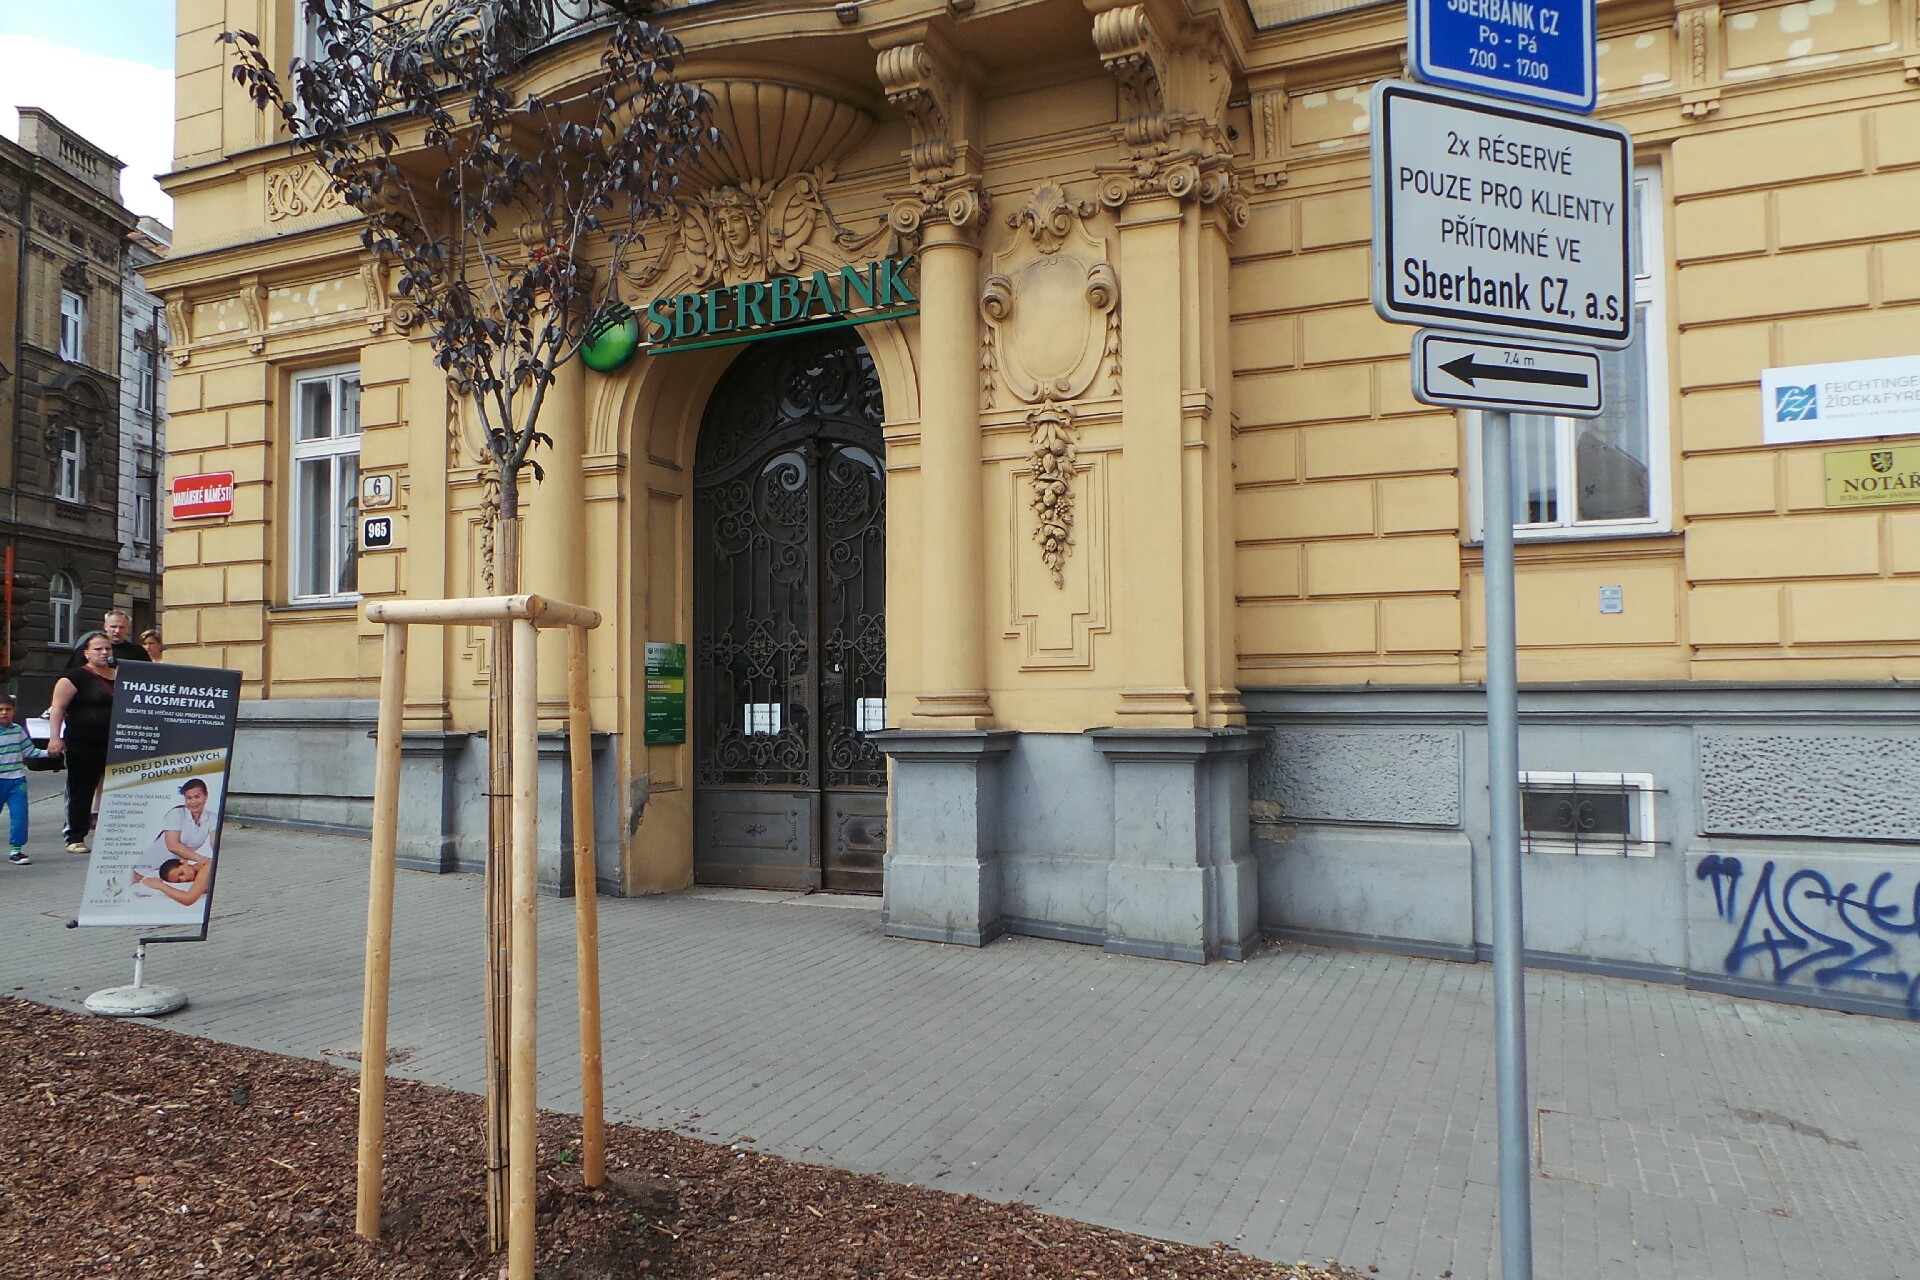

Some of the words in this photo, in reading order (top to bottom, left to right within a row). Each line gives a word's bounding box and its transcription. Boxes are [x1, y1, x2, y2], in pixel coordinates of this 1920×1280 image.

[1540, 8, 1559, 36] CZ
[1479, 25, 1499, 46] Po
[1518, 33, 1537, 53] Pá
[1469, 48, 1497, 70] 7.00
[1516, 58, 1549, 81] 17.00
[1447, 130, 1470, 158] 2x
[1478, 134, 1573, 176] RÉSERVÉ
[1400, 166, 1472, 202] POUZE
[1481, 180, 1522, 210] PRO
[1531, 189, 1615, 225] KLIENTY
[1441, 214, 1549, 258] PŘÍTOMNÉ
[1556, 236, 1581, 263] VE
[647, 256, 917, 344] SBERBANK
[1403, 258, 1531, 311] Sberbank
[1540, 275, 1576, 319] CZ,
[1504, 351, 1519, 365] 7,4
[1523, 357, 1535, 366] m
[173, 486, 204, 506] MARIÁNSKÉ
[204, 483, 232, 503] NÁMĚSTÍ
[372, 478, 381, 496] 6
[368, 521, 387, 539] 965
[122, 681, 176, 695] THAJSKÉ
[178, 685, 229, 699] MASÁŽE
[132, 694, 142, 704] A
[144, 694, 216, 709] KOSMETIKA
[111, 764, 152, 776] PRODEJ
[154, 752, 220, 769] DÁRKOVÝCH
[141, 765, 193, 780] POUKAZŮ
